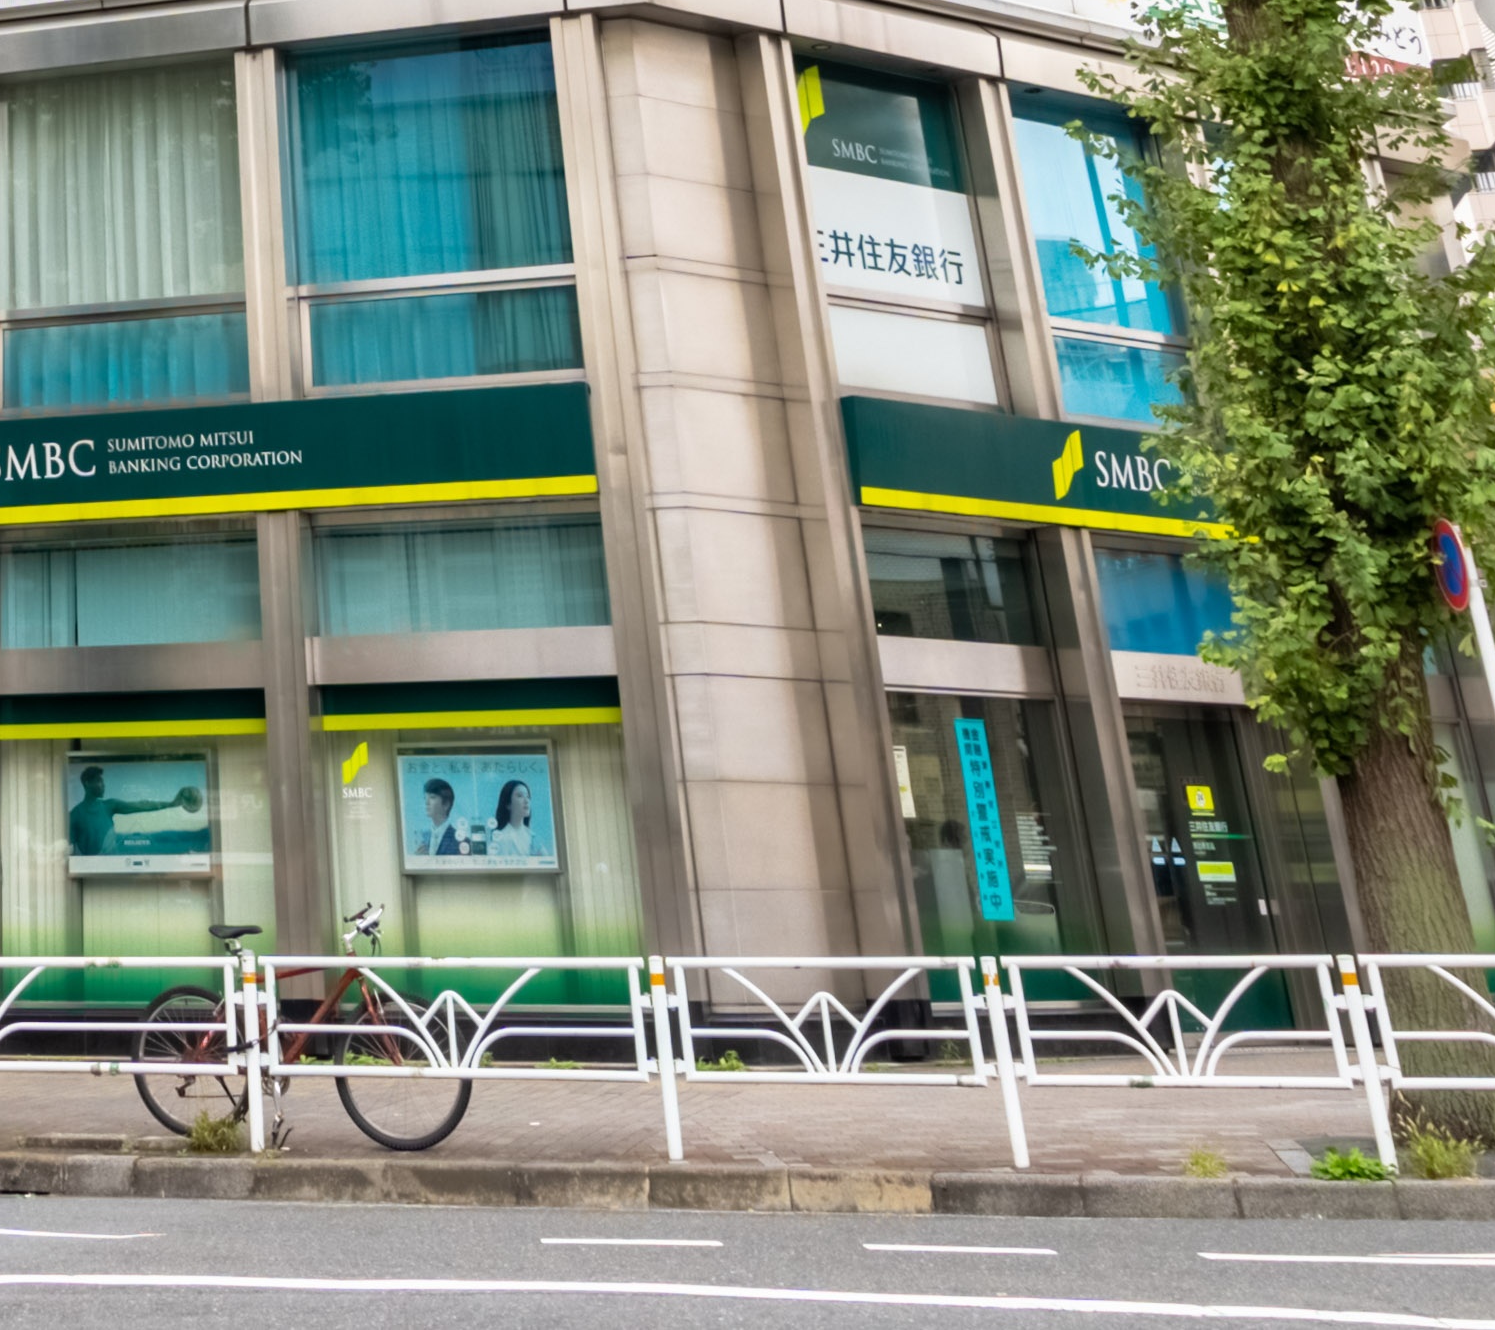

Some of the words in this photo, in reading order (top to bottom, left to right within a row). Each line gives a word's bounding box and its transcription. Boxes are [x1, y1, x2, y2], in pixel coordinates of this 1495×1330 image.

[832, 138, 877, 164] SMBC
[107, 434, 195, 453] SUMITOMO
[199, 430, 254, 447] MITSUI
[108, 456, 181, 475] BANKING
[186, 450, 303, 471] CORPORATION
[1094, 450, 1171, 494] SMBC
[342, 787, 373, 799] SMBC
